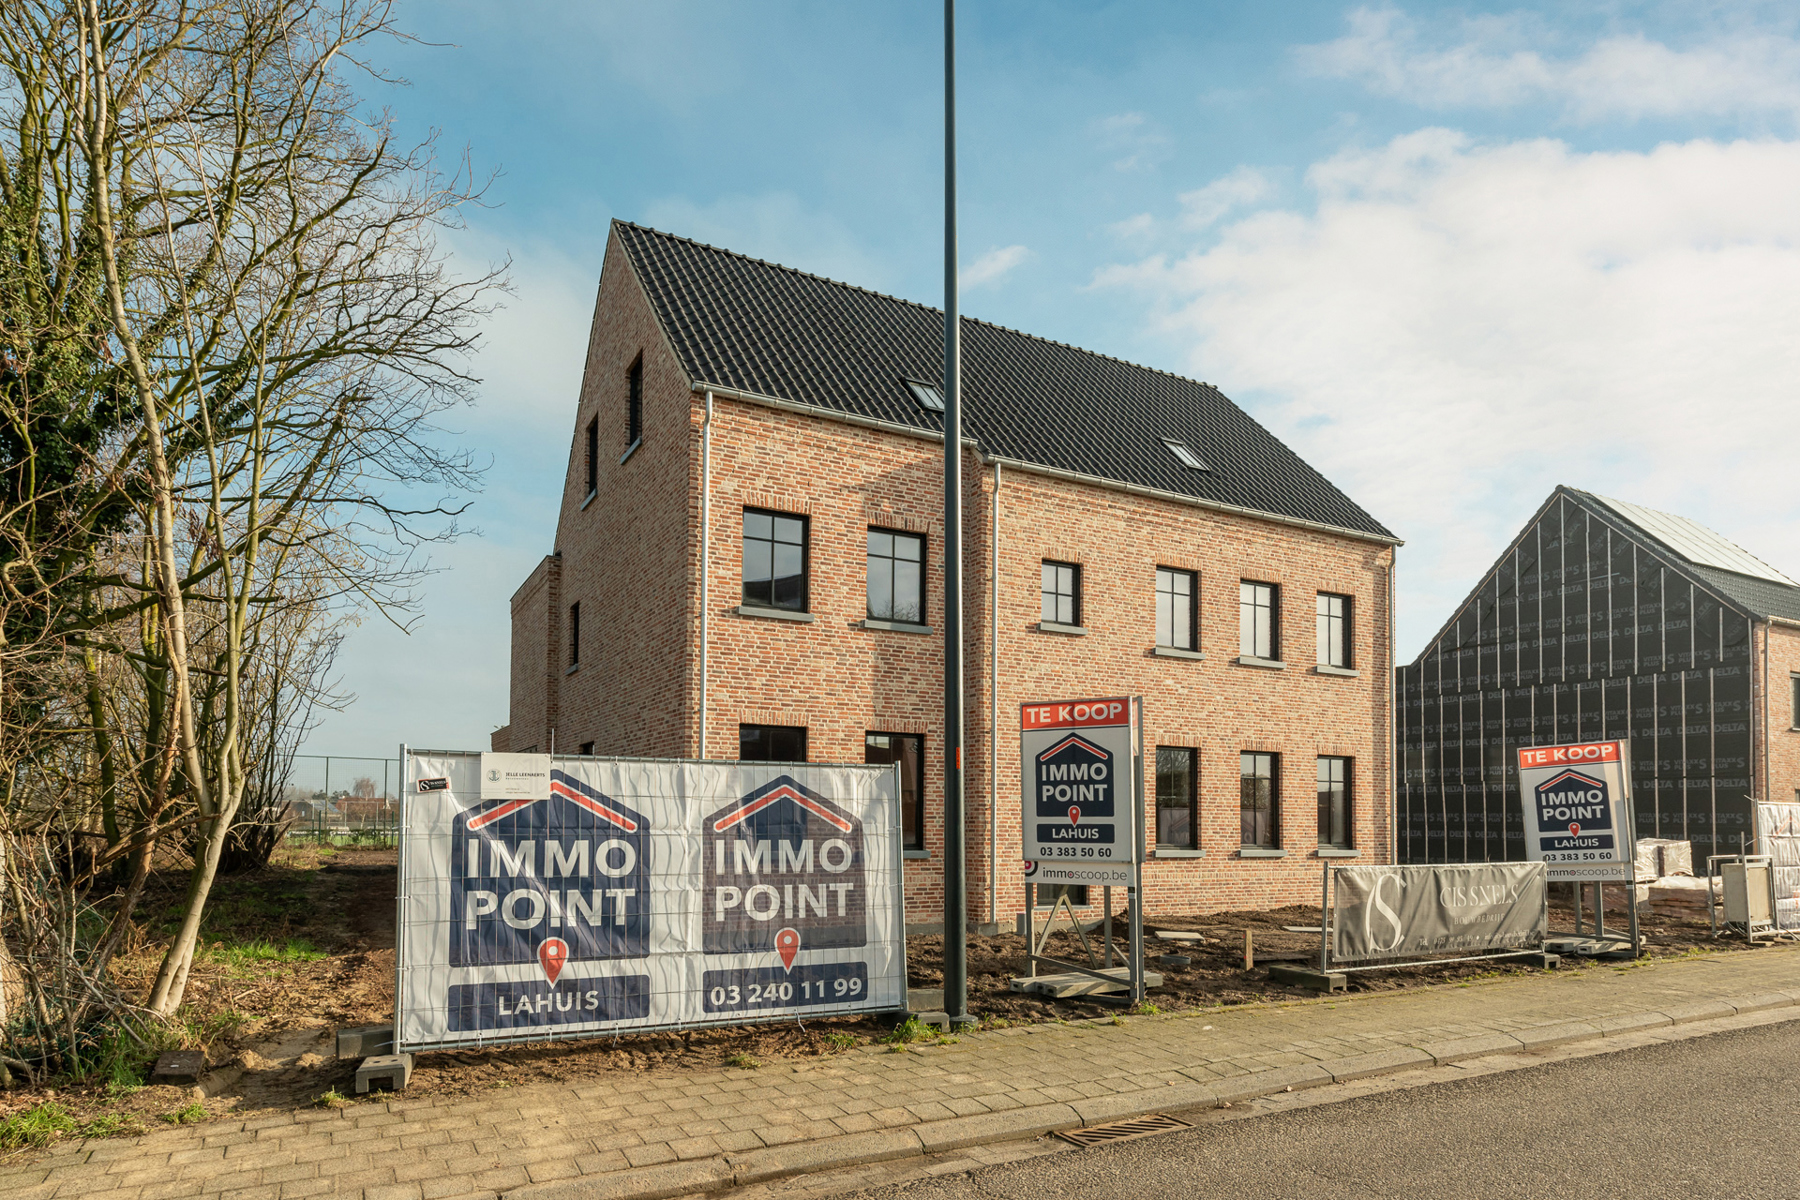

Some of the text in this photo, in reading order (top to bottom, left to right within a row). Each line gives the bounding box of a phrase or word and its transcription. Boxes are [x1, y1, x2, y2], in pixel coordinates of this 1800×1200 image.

[1027, 702, 1122, 724] TE KOOP
[1524, 745, 1614, 764] TE KOOP
[1042, 762, 1108, 781] IMMO
[1042, 784, 1108, 802] POINT
[1541, 790, 1603, 806] IMMO
[1542, 805, 1604, 821] POINT
[1052, 827, 1100, 840] LAHUIS
[1554, 838, 1599, 848] LAHUIS
[466, 838, 636, 878] IMMO
[715, 838, 853, 876] IMMO
[1040, 846, 1112, 858] 03 383 50 60
[1043, 867, 1128, 883] immoscoop.be
[715, 882, 854, 922] POINT
[1440, 886, 1467, 908] CIS
[466, 888, 636, 930] POINT
[711, 976, 862, 1007] 03 240 11 99
[499, 990, 599, 1017] LAHUIS
